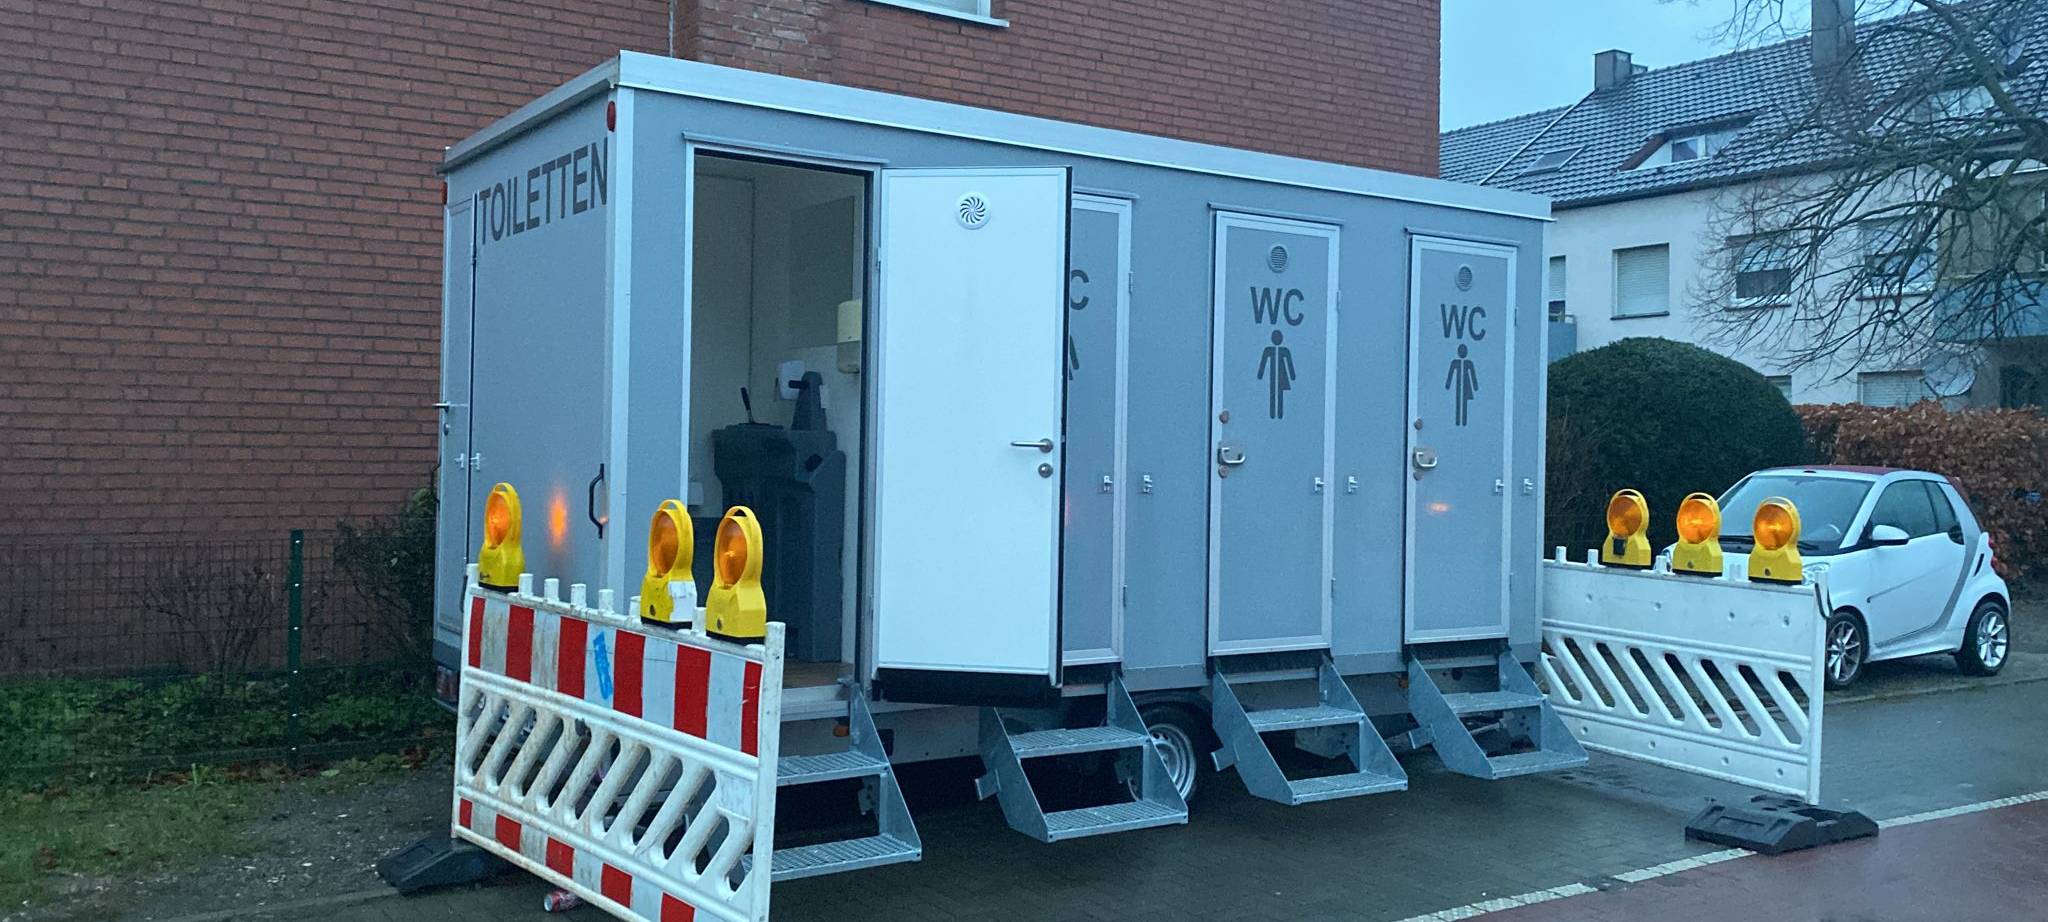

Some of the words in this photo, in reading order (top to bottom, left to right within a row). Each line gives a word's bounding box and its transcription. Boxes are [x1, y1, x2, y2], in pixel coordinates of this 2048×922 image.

[478, 136, 608, 245] TOILETTEN
[1070, 269, 1090, 311] C
[1250, 286, 1304, 326] WC
[1440, 303, 1486, 341] WC
